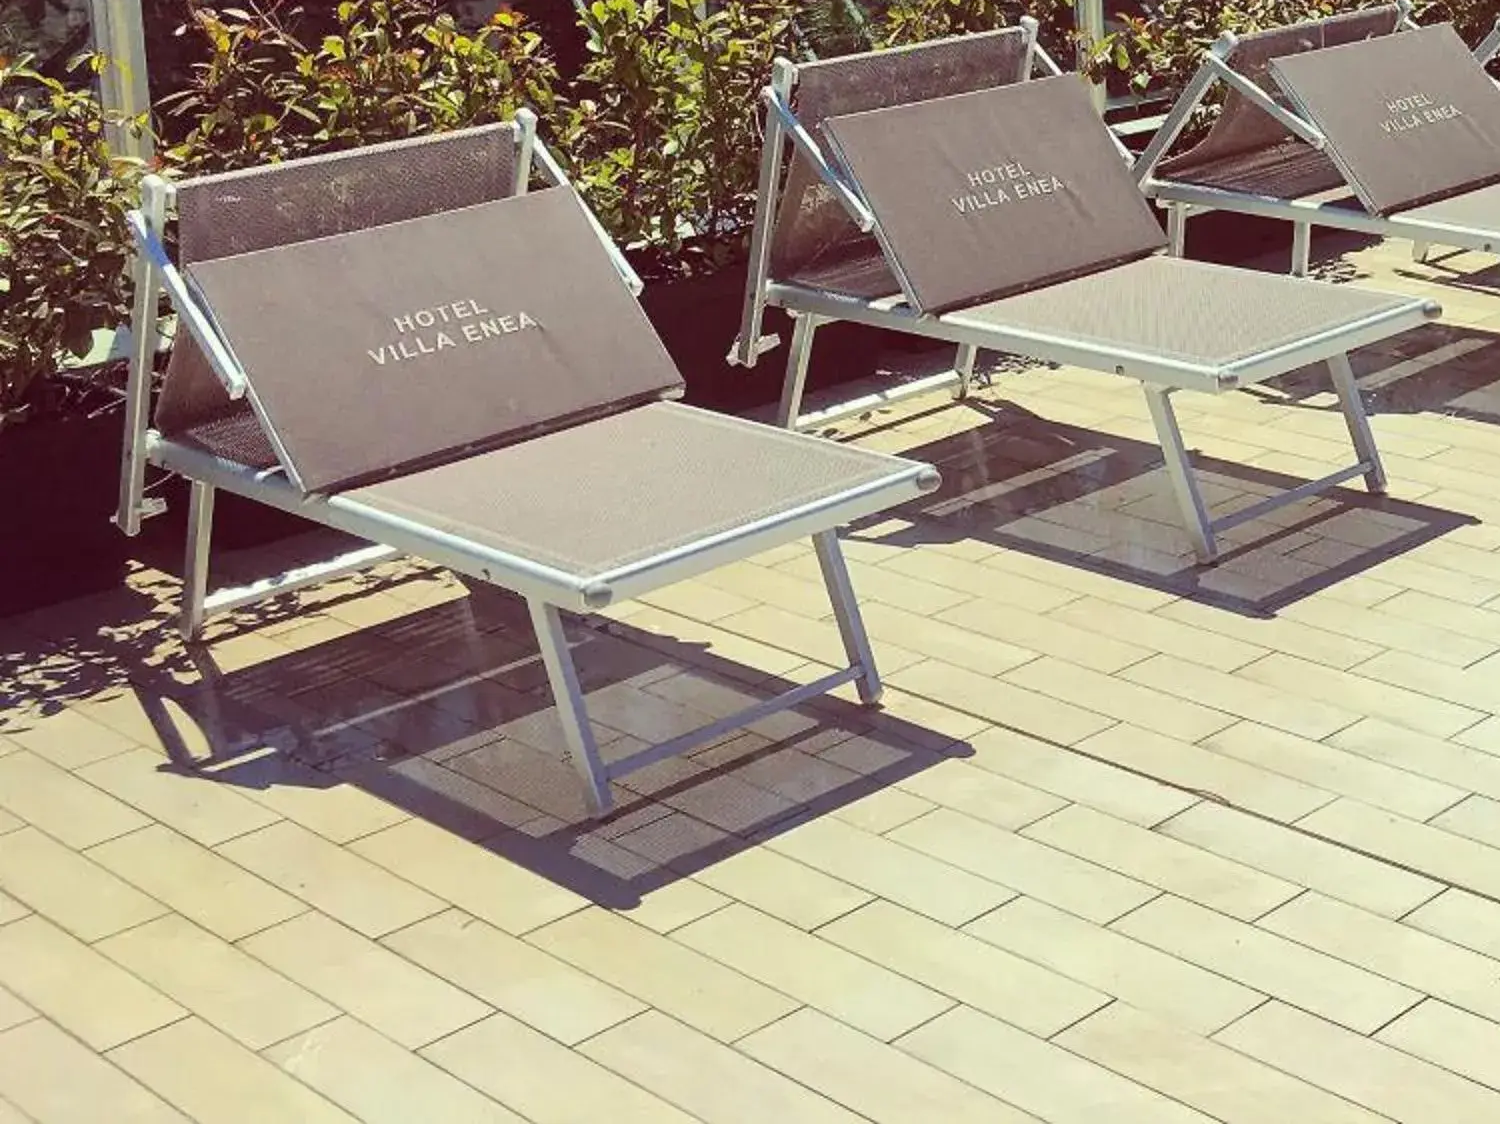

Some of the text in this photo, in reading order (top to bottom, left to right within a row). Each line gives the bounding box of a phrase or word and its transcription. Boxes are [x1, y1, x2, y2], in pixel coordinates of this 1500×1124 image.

[1385, 93, 1434, 113] HOTEL
[1379, 114, 1422, 132] VILLA
[967, 163, 1031, 187] HOTEL
[951, 175, 1064, 213] VILLA ENEA
[394, 299, 489, 333] HOTEL
[367, 311, 537, 365] VILLA ENEA
